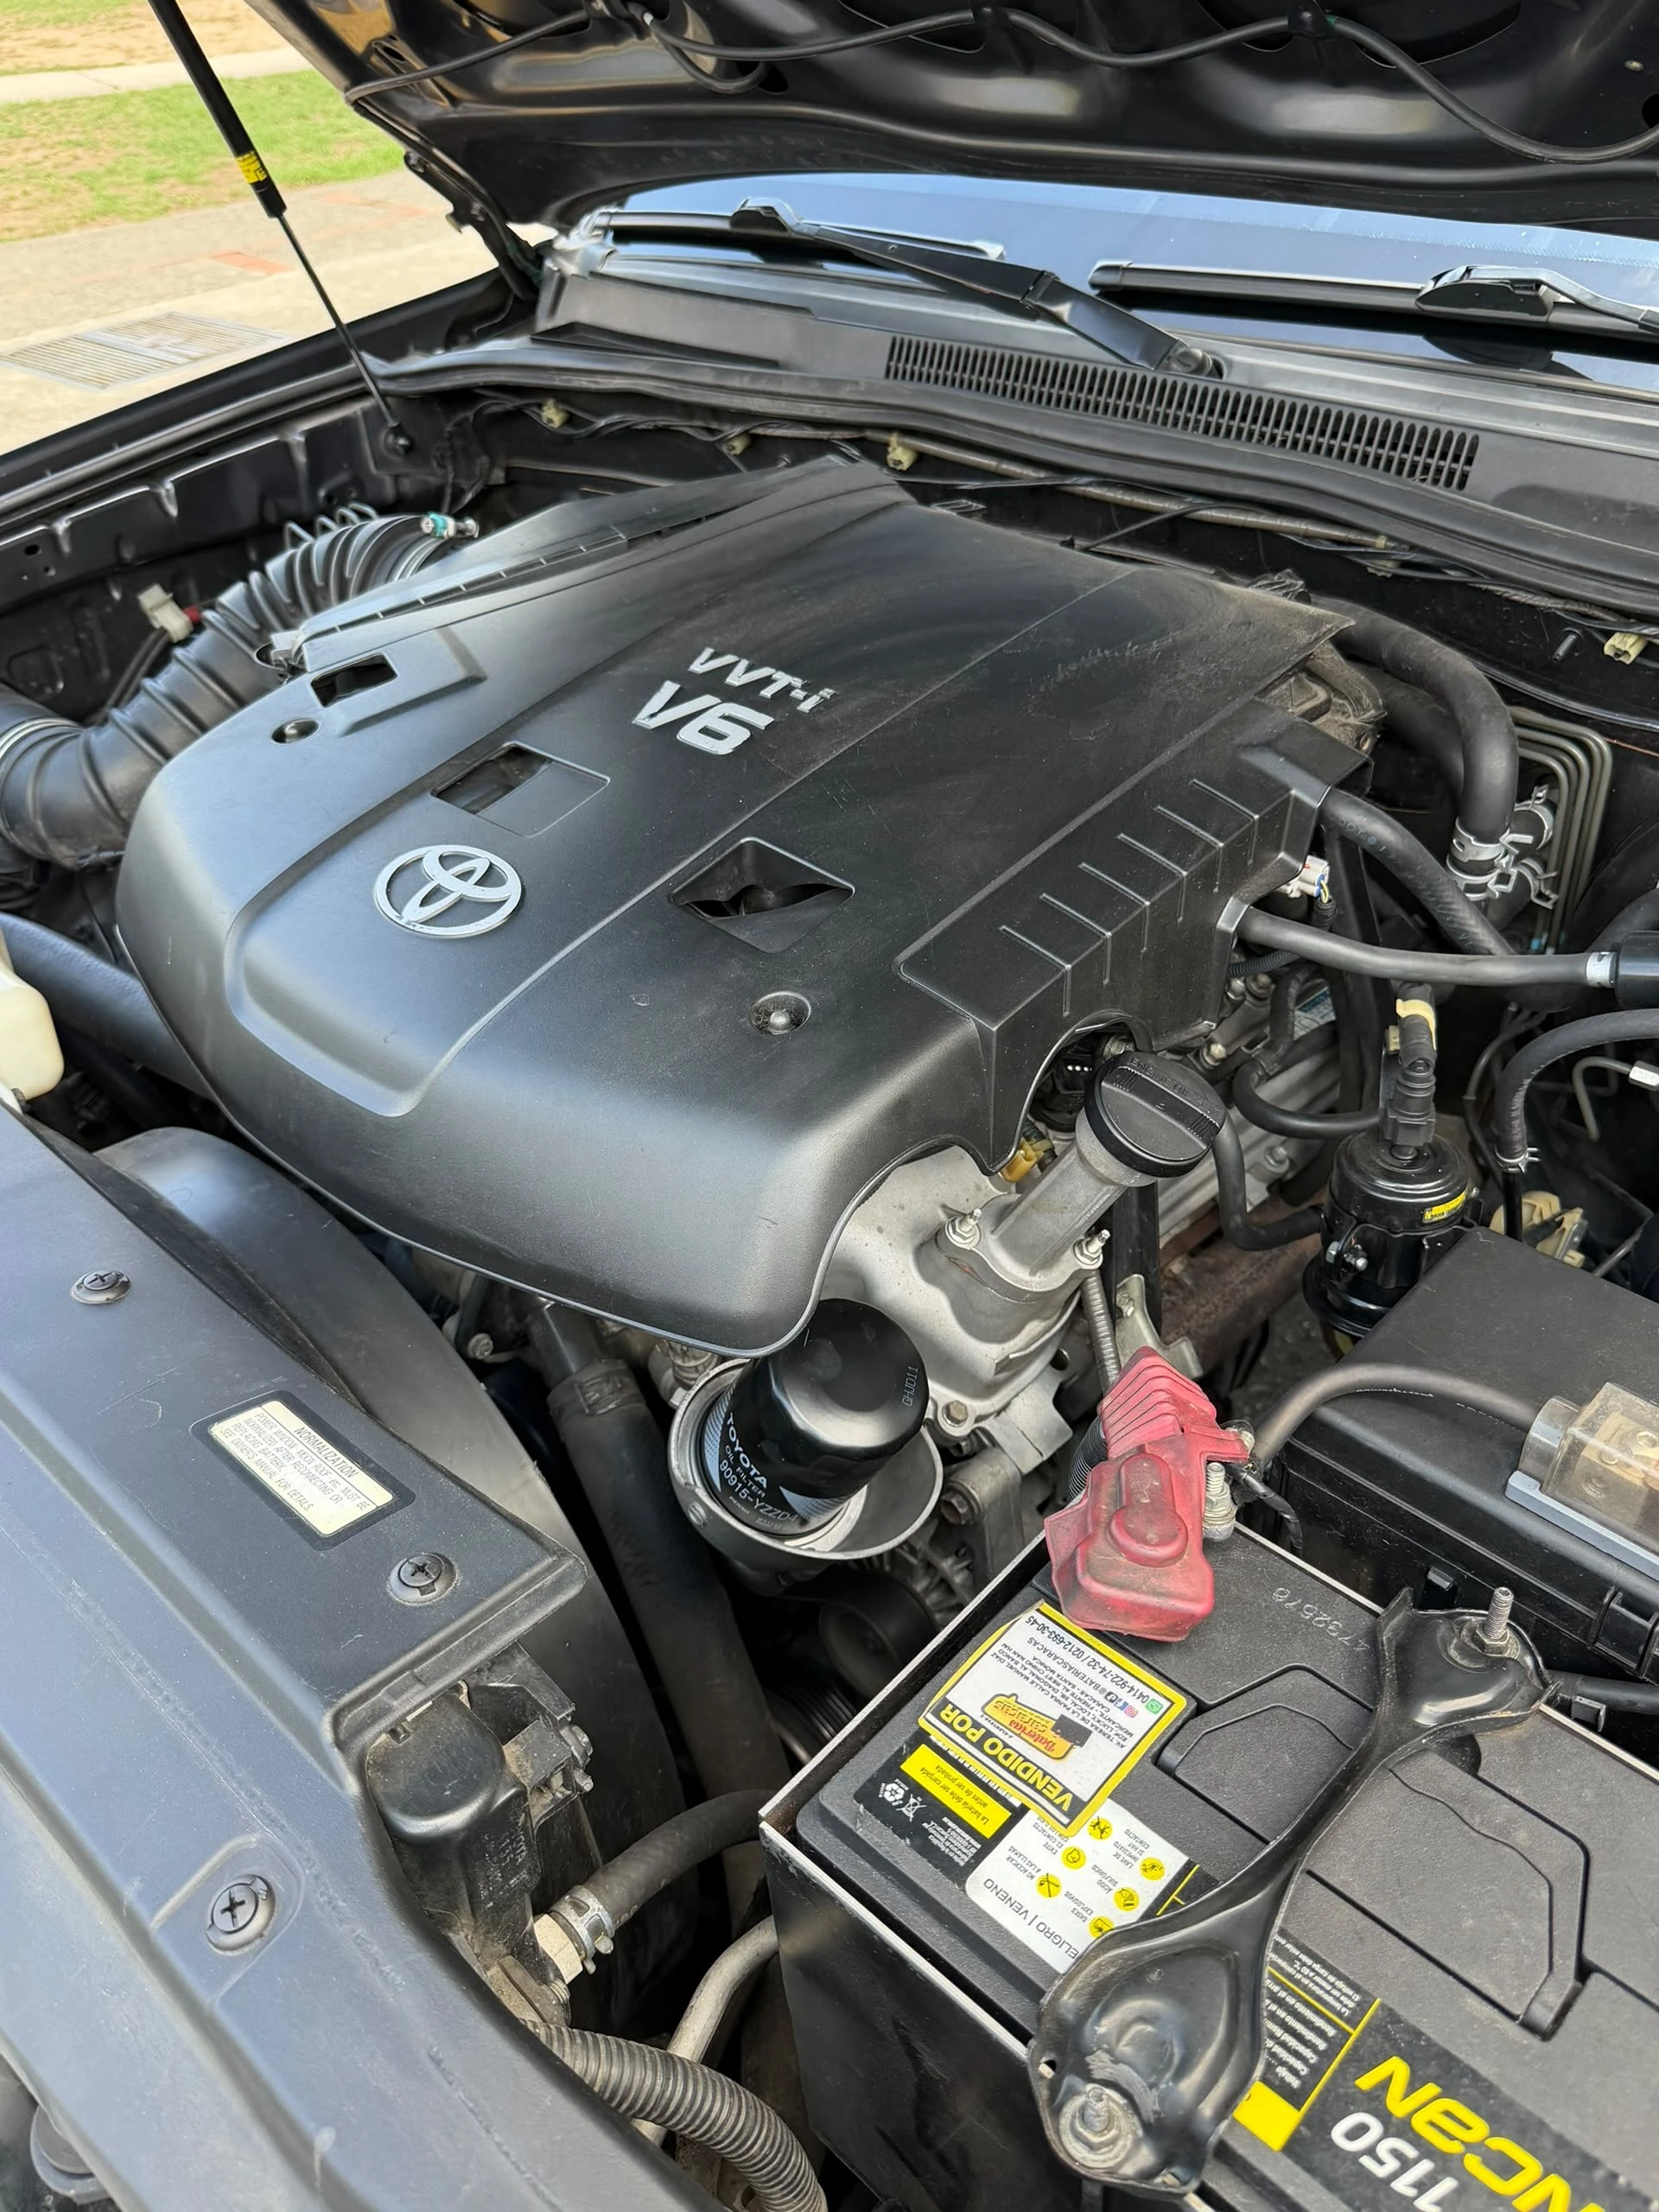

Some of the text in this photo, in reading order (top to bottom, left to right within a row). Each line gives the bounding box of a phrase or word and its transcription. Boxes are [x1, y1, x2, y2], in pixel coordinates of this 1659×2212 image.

[689, 647, 836, 714] VVT-i
[632, 679, 774, 755] V6
[232, 1423, 264, 1449] REPLACING
[219, 1428, 236, 1440] SEE
[254, 1459, 281, 1479] MANUAL
[275, 1478, 293, 1491] FOR
[294, 1427, 359, 1478] NORMALIZATION
[724, 1411, 767, 1489] TOYOTA
[243, 1418, 345, 1504] NORMALIZED AFTER RECONNECTING OR
[254, 1413, 278, 1431] POWER
[273, 1429, 300, 1449] WINDOW
[313, 1463, 334, 1478] ROOF
[340, 1486, 362, 1503] MUST
[356, 1501, 372, 1511] BE
[725, 1444, 735, 1465] OIL
[736, 1465, 766, 1497] FILTER
[1025, 1616, 1086, 1659] 0212-693-30-45
[998, 1649, 1020, 1666] BANCO
[1019, 1663, 1029, 1672] AL
[1025, 1660, 1046, 1675] CHINO
[1027, 1637, 1109, 1696] @BATERIASCARACAS
[1004, 1662, 1031, 1681] MANUEL
[1027, 1669, 1060, 1694] DIAGONAL
[1055, 1673, 1077, 1689] SANTA
[1086, 1657, 1150, 1704] 0414-922-74-32
[1029, 1680, 1051, 1696] CALLE
[1049, 1694, 1071, 1711] PARRA
[1069, 1699, 1092, 1717] LOCAL
[1070, 1691, 1096, 1711] FRENTE
[1079, 1690, 1111, 1713] CARACAS
[939, 1703, 986, 1741] POR
[1071, 1709, 1081, 1718] LA
[1080, 1716, 1090, 1725] DE
[1089, 1722, 1116, 1743] TERESA
[1097, 1711, 1135, 1738] MERCANTIL
[1007, 1719, 1058, 1754] Baterias
[983, 1735, 1075, 1811] VENDIDO
[919, 1767, 990, 1825] La batería debe ser cargada
[934, 1764, 988, 1809] antes de ser probada
[1032, 1822, 1058, 1844] CONTACTO
[1123, 1829, 1151, 1850] CONTACTO
[1008, 1846, 1028, 1863] LLAMAS
[1042, 1842, 1059, 1855] EVITE
[1113, 1841, 1140, 1862] INMEDIATO
[1127, 1842, 1140, 1852] HAY
[1006, 1855, 1036, 1880] NO ACERCAR
[1026, 1860, 1038, 1871] LAS
[1119, 1857, 1135, 1869] LAVE
[983, 1878, 1032, 1918] VENENO
[1064, 1891, 1095, 1916] EXPLOSIVOS
[1071, 1908, 1089, 1923] GASES
[1034, 1921, 1080, 1959] ELIGRO
[1284, 1942, 1300, 1959] estar
[1298, 1952, 1313, 1968] debe
[1311, 1962, 1329, 1979] carga
[1300, 1976, 1310, 1986] en
[1313, 1974, 1332, 1993] menor
[1326, 1974, 1337, 1985] de
[1334, 1980, 1354, 1998] voltaje
[1278, 1988, 1287, 2000] el
[1285, 1993, 1296, 2007] en
[1307, 1981, 1343, 2012] temperatura
[1330, 1987, 1342, 1999] ser
[1339, 1994, 1356, 2009] debe
[1268, 2002, 1278, 2013] el
[1275, 2007, 1287, 2020] en
[1340, 2005, 1351, 2017] La
[1294, 2000, 1337, 2038] Rendimiento
[1284, 2014, 1328, 2051] Rendimiento
[1281, 2031, 1319, 2064] Capacidad
[1271, 2044, 1309, 2077] Capacidad
[1275, 2064, 1301, 2089] Voltaje
[1330, 2112, 1459, 2212] 1150
